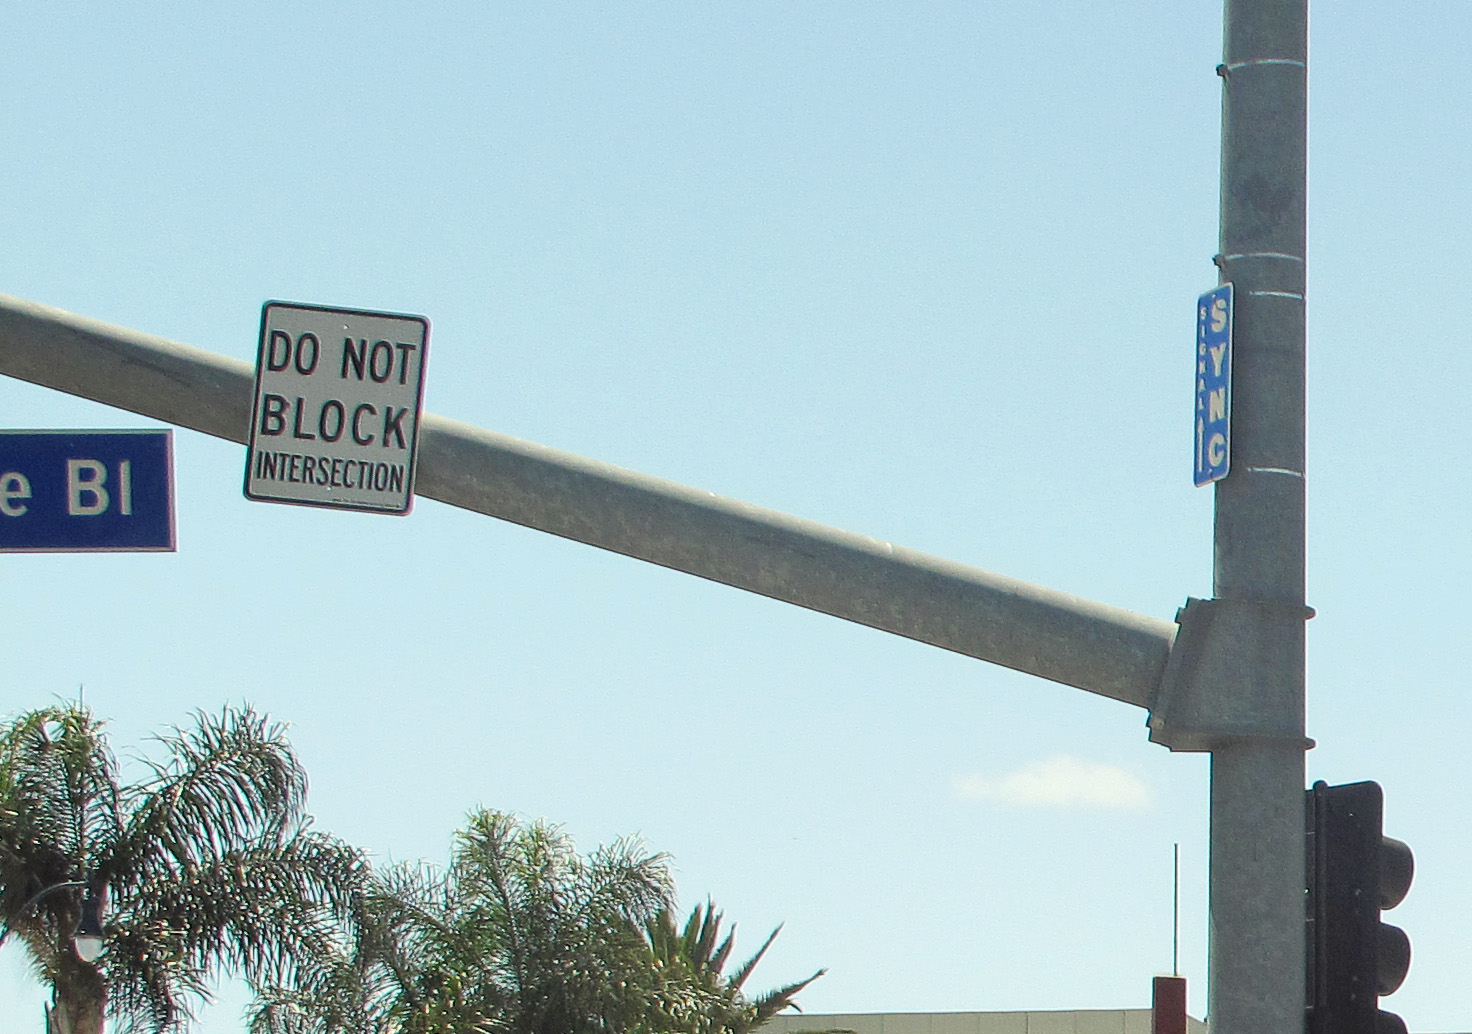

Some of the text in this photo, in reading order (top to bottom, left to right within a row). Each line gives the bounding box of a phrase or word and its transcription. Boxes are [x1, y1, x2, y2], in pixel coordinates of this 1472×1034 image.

[268, 329, 418, 385] DO NOT
[1208, 298, 1229, 468] SYNC
[261, 393, 410, 450] BLOCK
[67, 458, 133, 516] Bl
[256, 451, 405, 493] INTERSECTION
